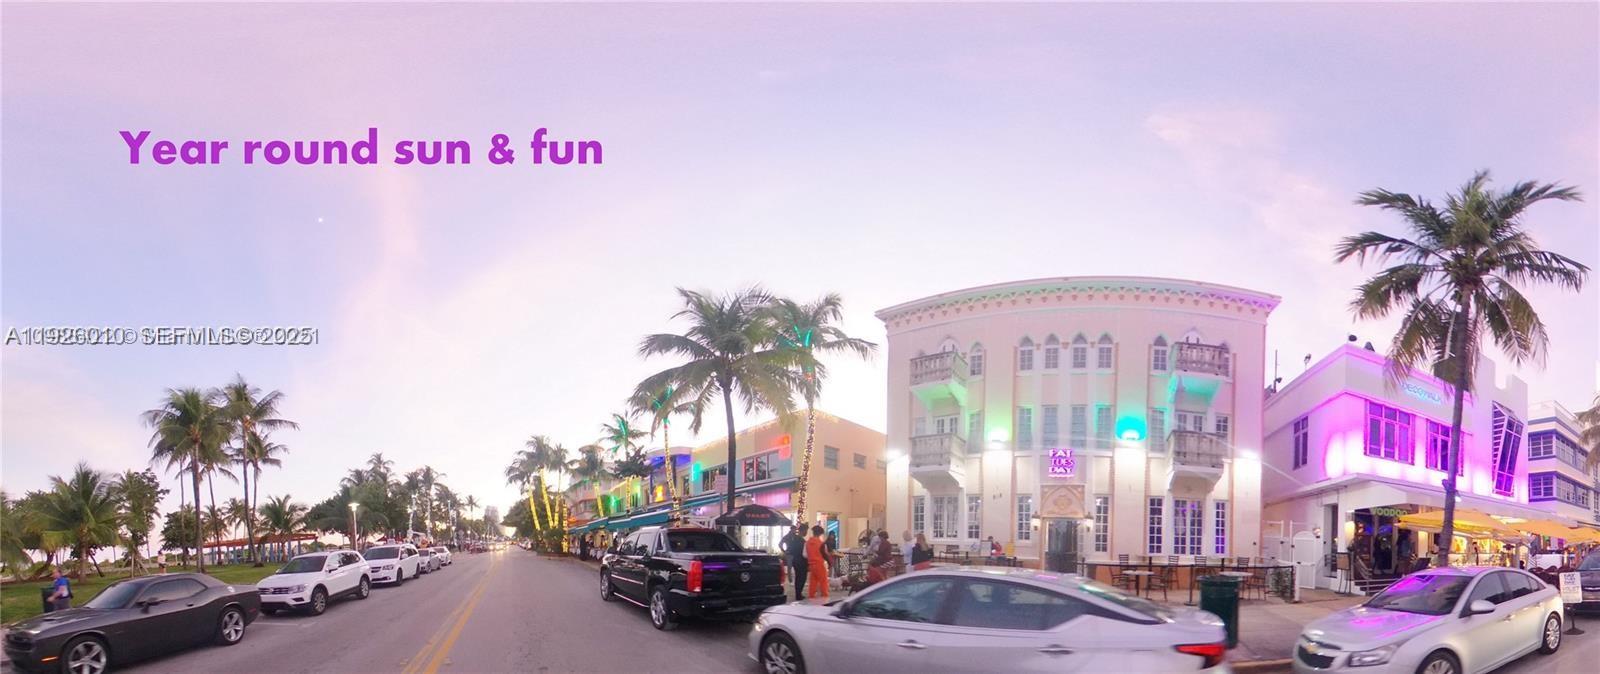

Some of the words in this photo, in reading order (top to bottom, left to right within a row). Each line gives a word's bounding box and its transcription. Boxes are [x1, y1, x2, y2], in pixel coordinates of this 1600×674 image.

[1048, 448, 1073, 457] FAT
[1050, 457, 1075, 467] TUES
[1048, 466, 1073, 474] DAY
[1371, 506, 1408, 517] VOODOO
